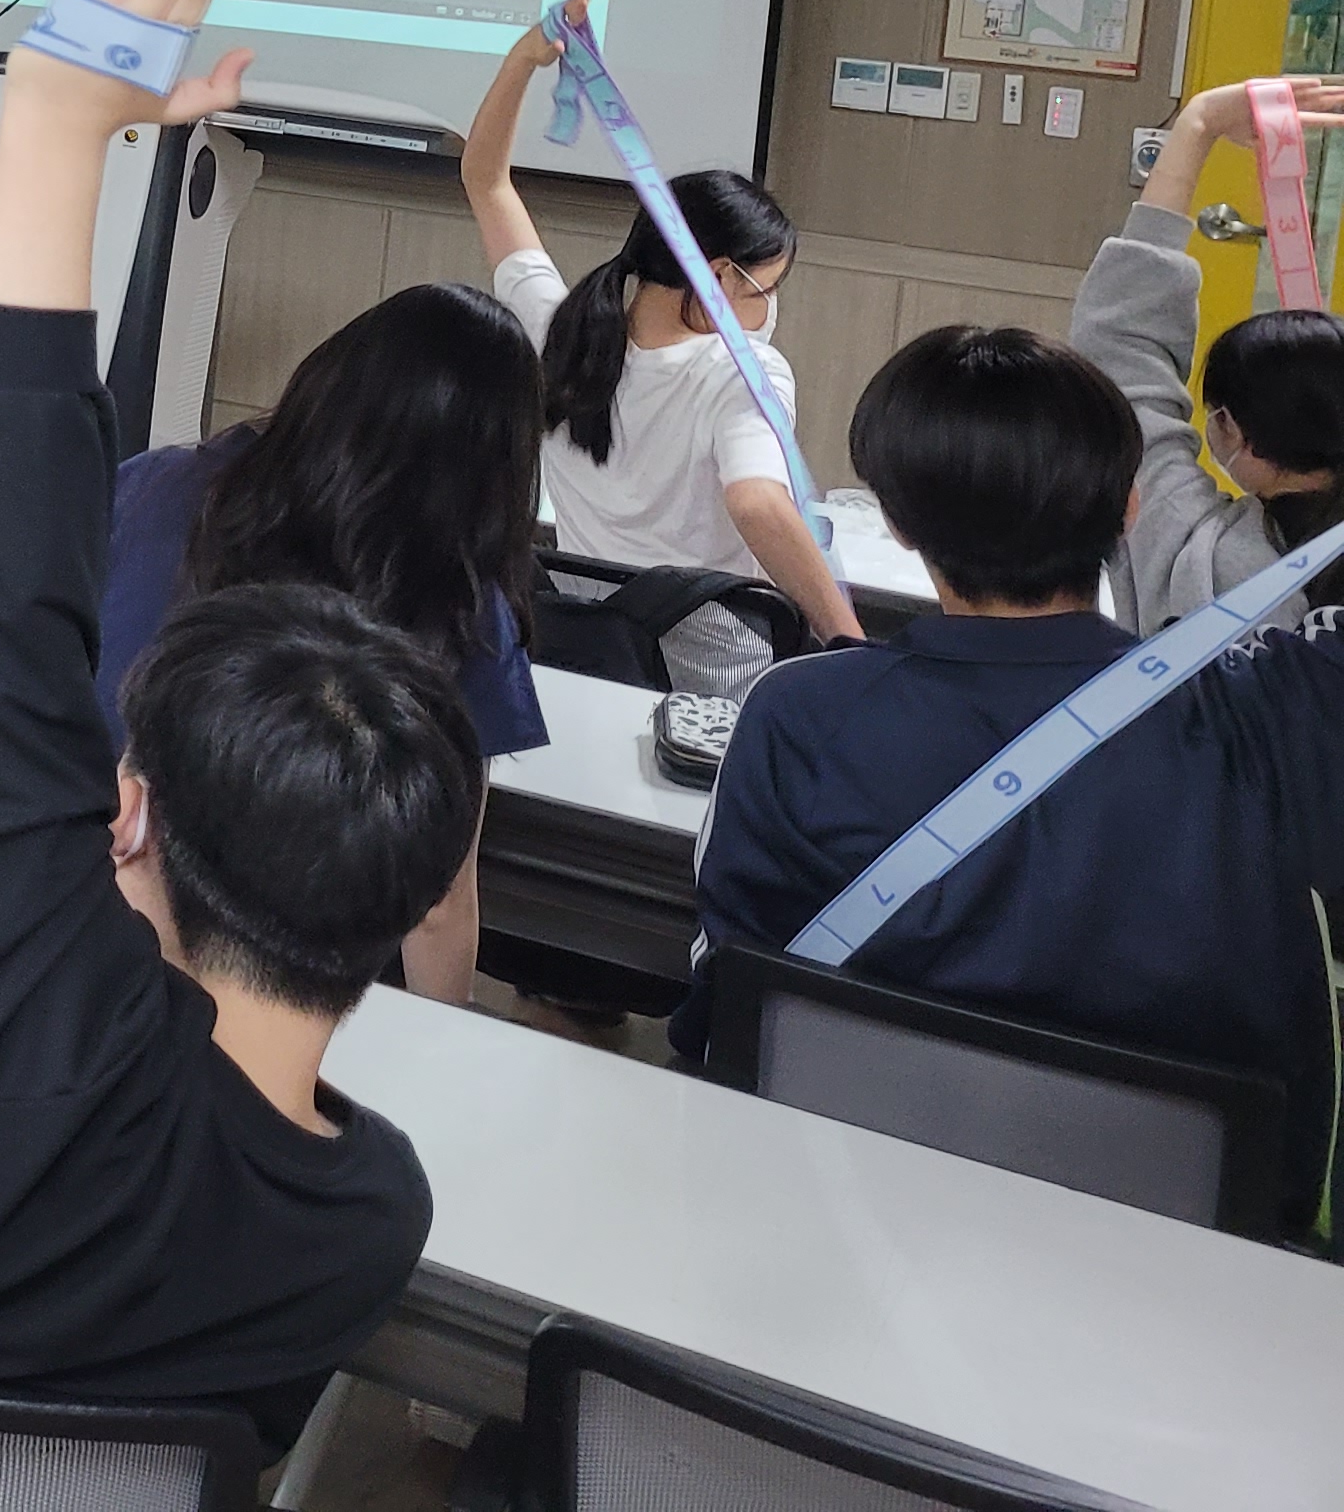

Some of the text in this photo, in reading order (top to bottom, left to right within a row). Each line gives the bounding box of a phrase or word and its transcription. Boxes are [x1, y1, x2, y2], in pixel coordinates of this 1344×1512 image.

[1137, 654, 1172, 682] 5
[992, 769, 1023, 797] 6
[870, 883, 896, 907] 7
